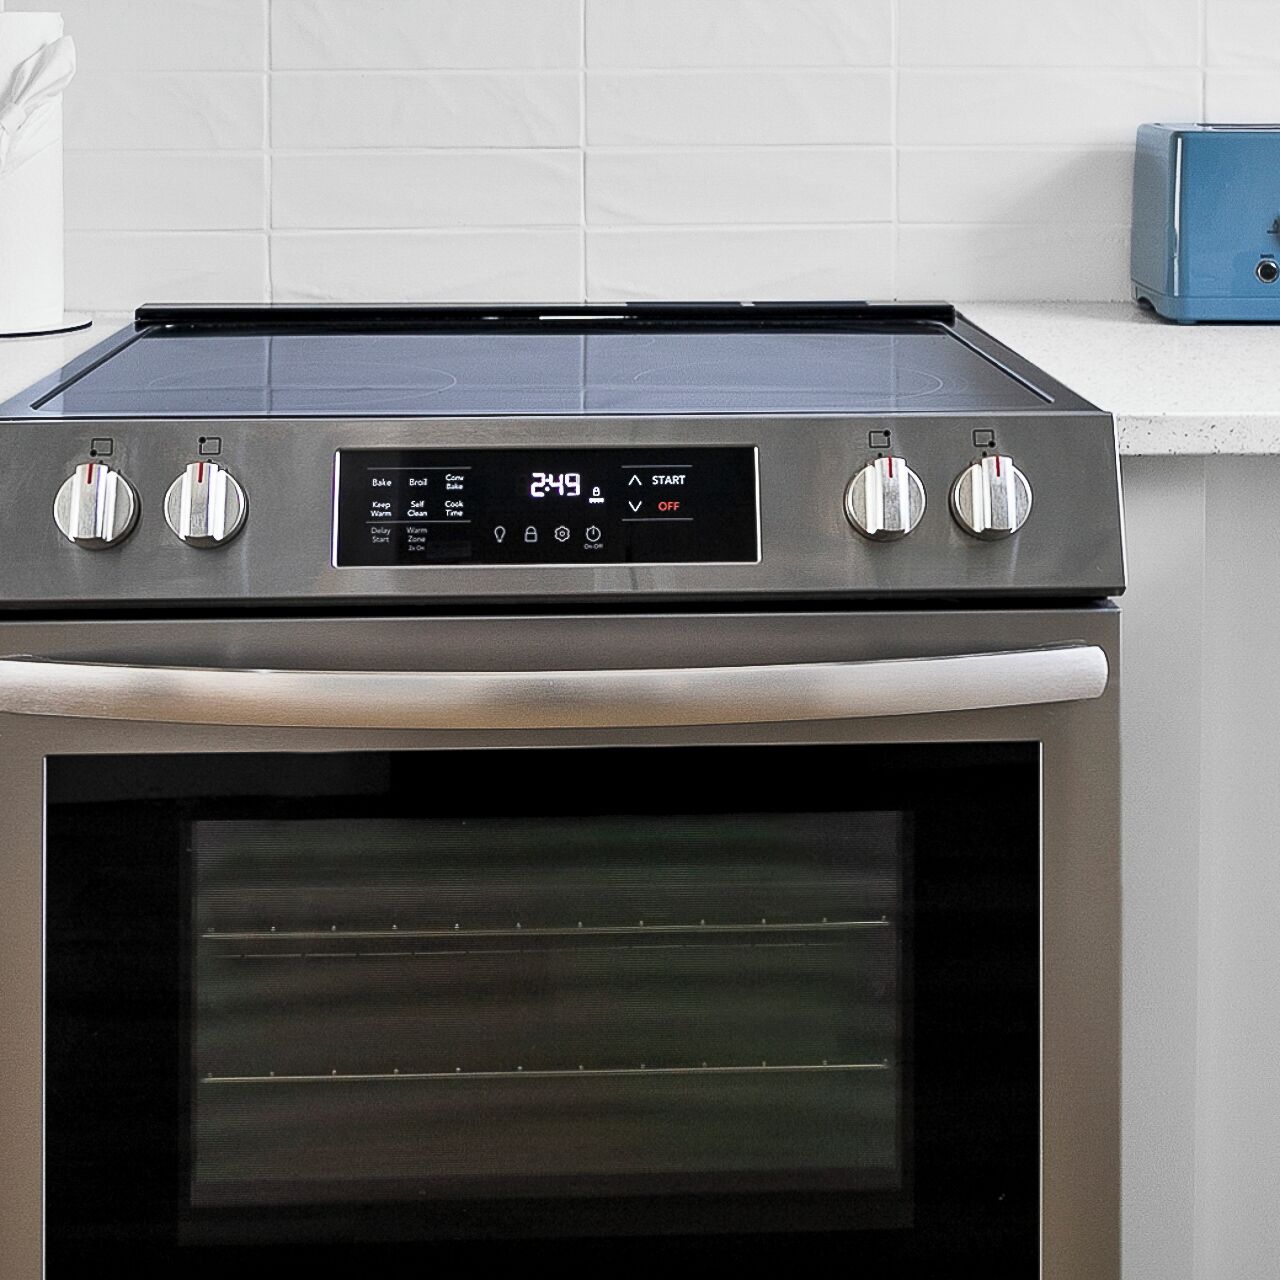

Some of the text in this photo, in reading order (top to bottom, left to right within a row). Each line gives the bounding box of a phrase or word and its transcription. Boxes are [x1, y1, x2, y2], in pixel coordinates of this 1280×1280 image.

[372, 478, 392, 487] Bake
[409, 478, 428, 486] Broil
[651, 474, 686, 486] START
[530, 472, 581, 498] 2:49
[372, 501, 391, 510] Keep
[410, 500, 425, 508] Self
[444, 500, 464, 508] Cook
[657, 501, 680, 512] OFF
[407, 509, 428, 517] Clean
[445, 509, 464, 517] Time
[371, 527, 391, 535] Delay
[408, 535, 426, 543] Zone
